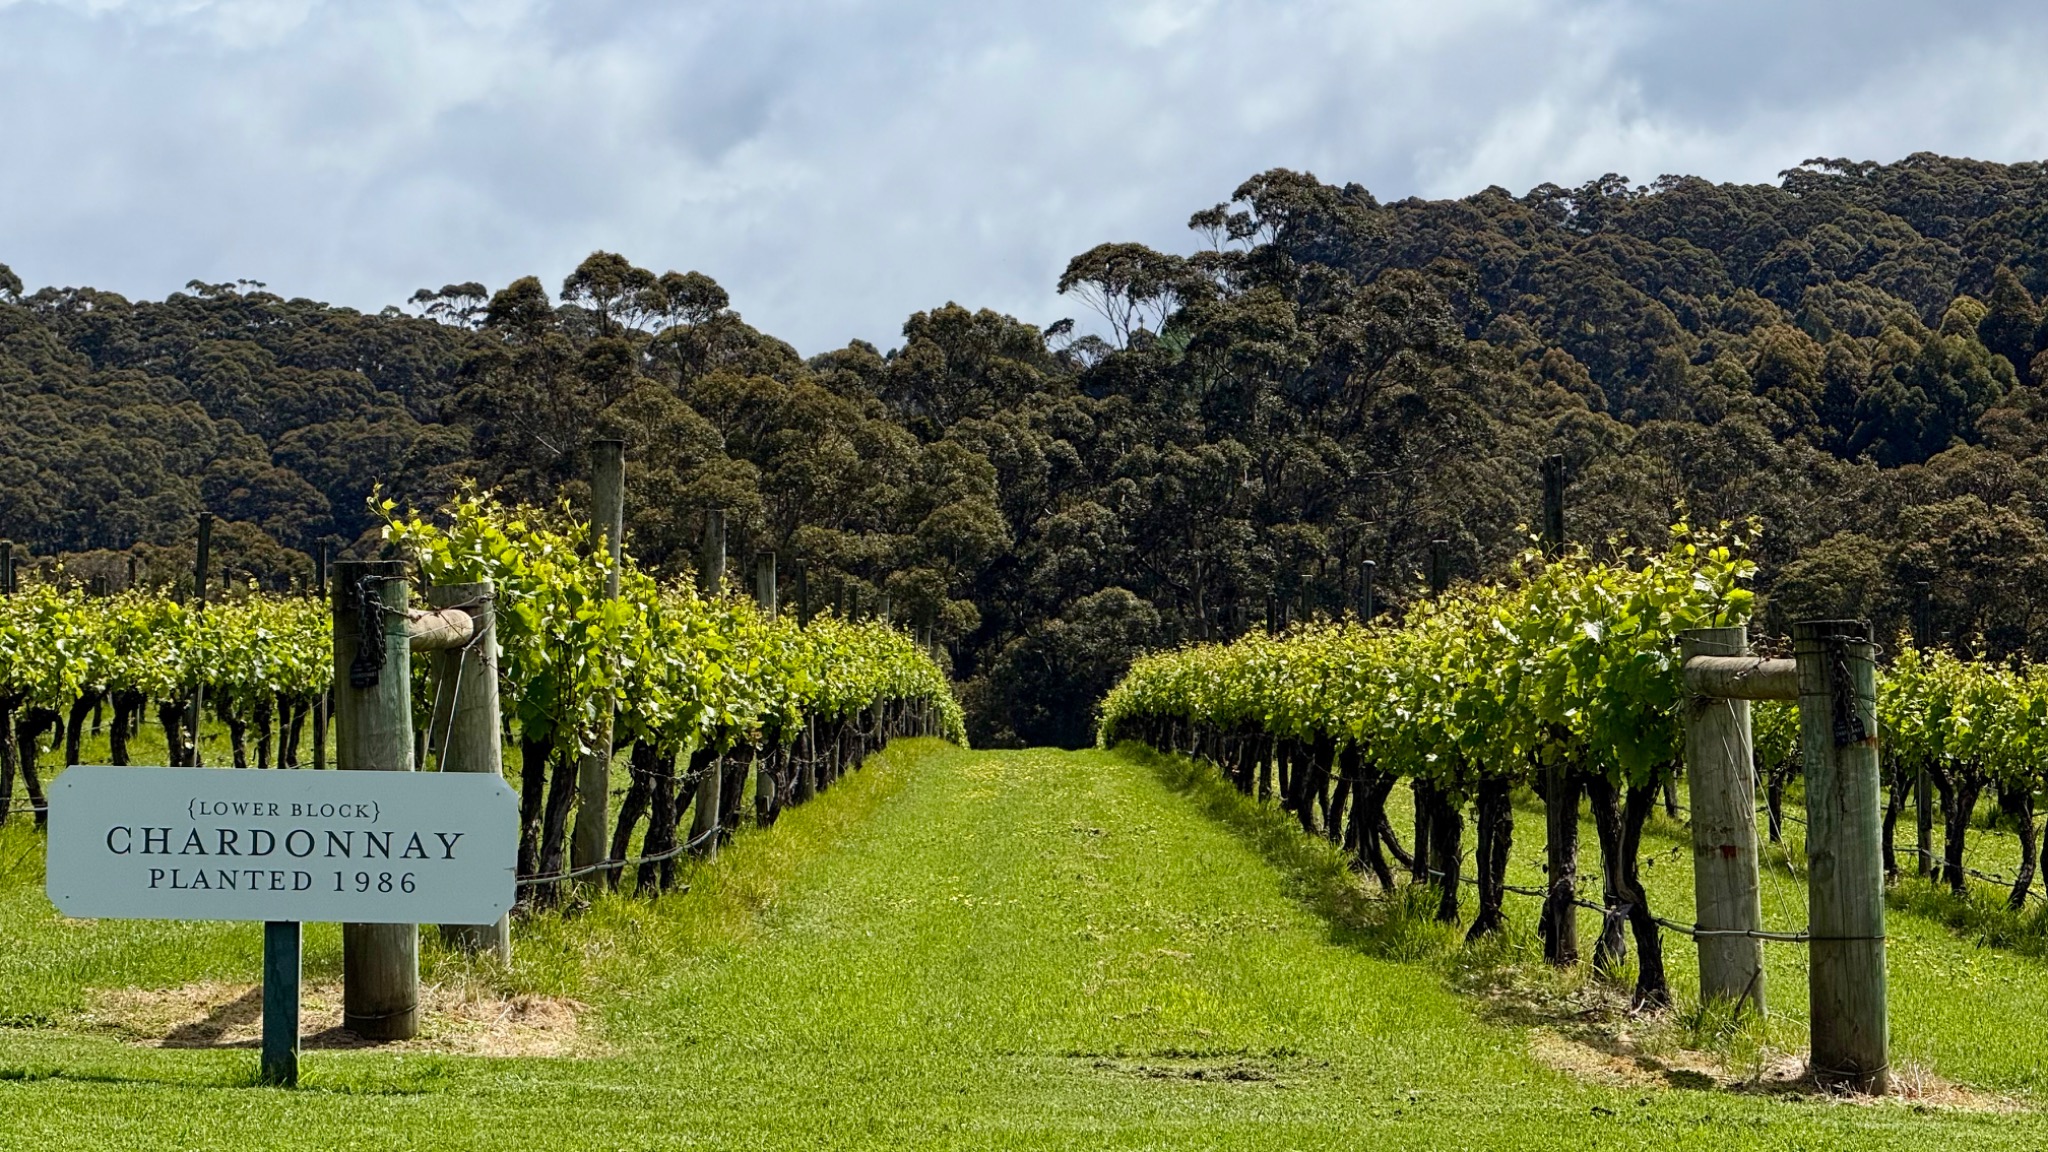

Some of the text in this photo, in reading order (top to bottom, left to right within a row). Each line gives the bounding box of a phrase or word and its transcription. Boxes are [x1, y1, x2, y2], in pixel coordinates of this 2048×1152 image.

[106, 826, 465, 861] CHARDONNAY
[147, 868, 417, 894] PLANTED 1986
